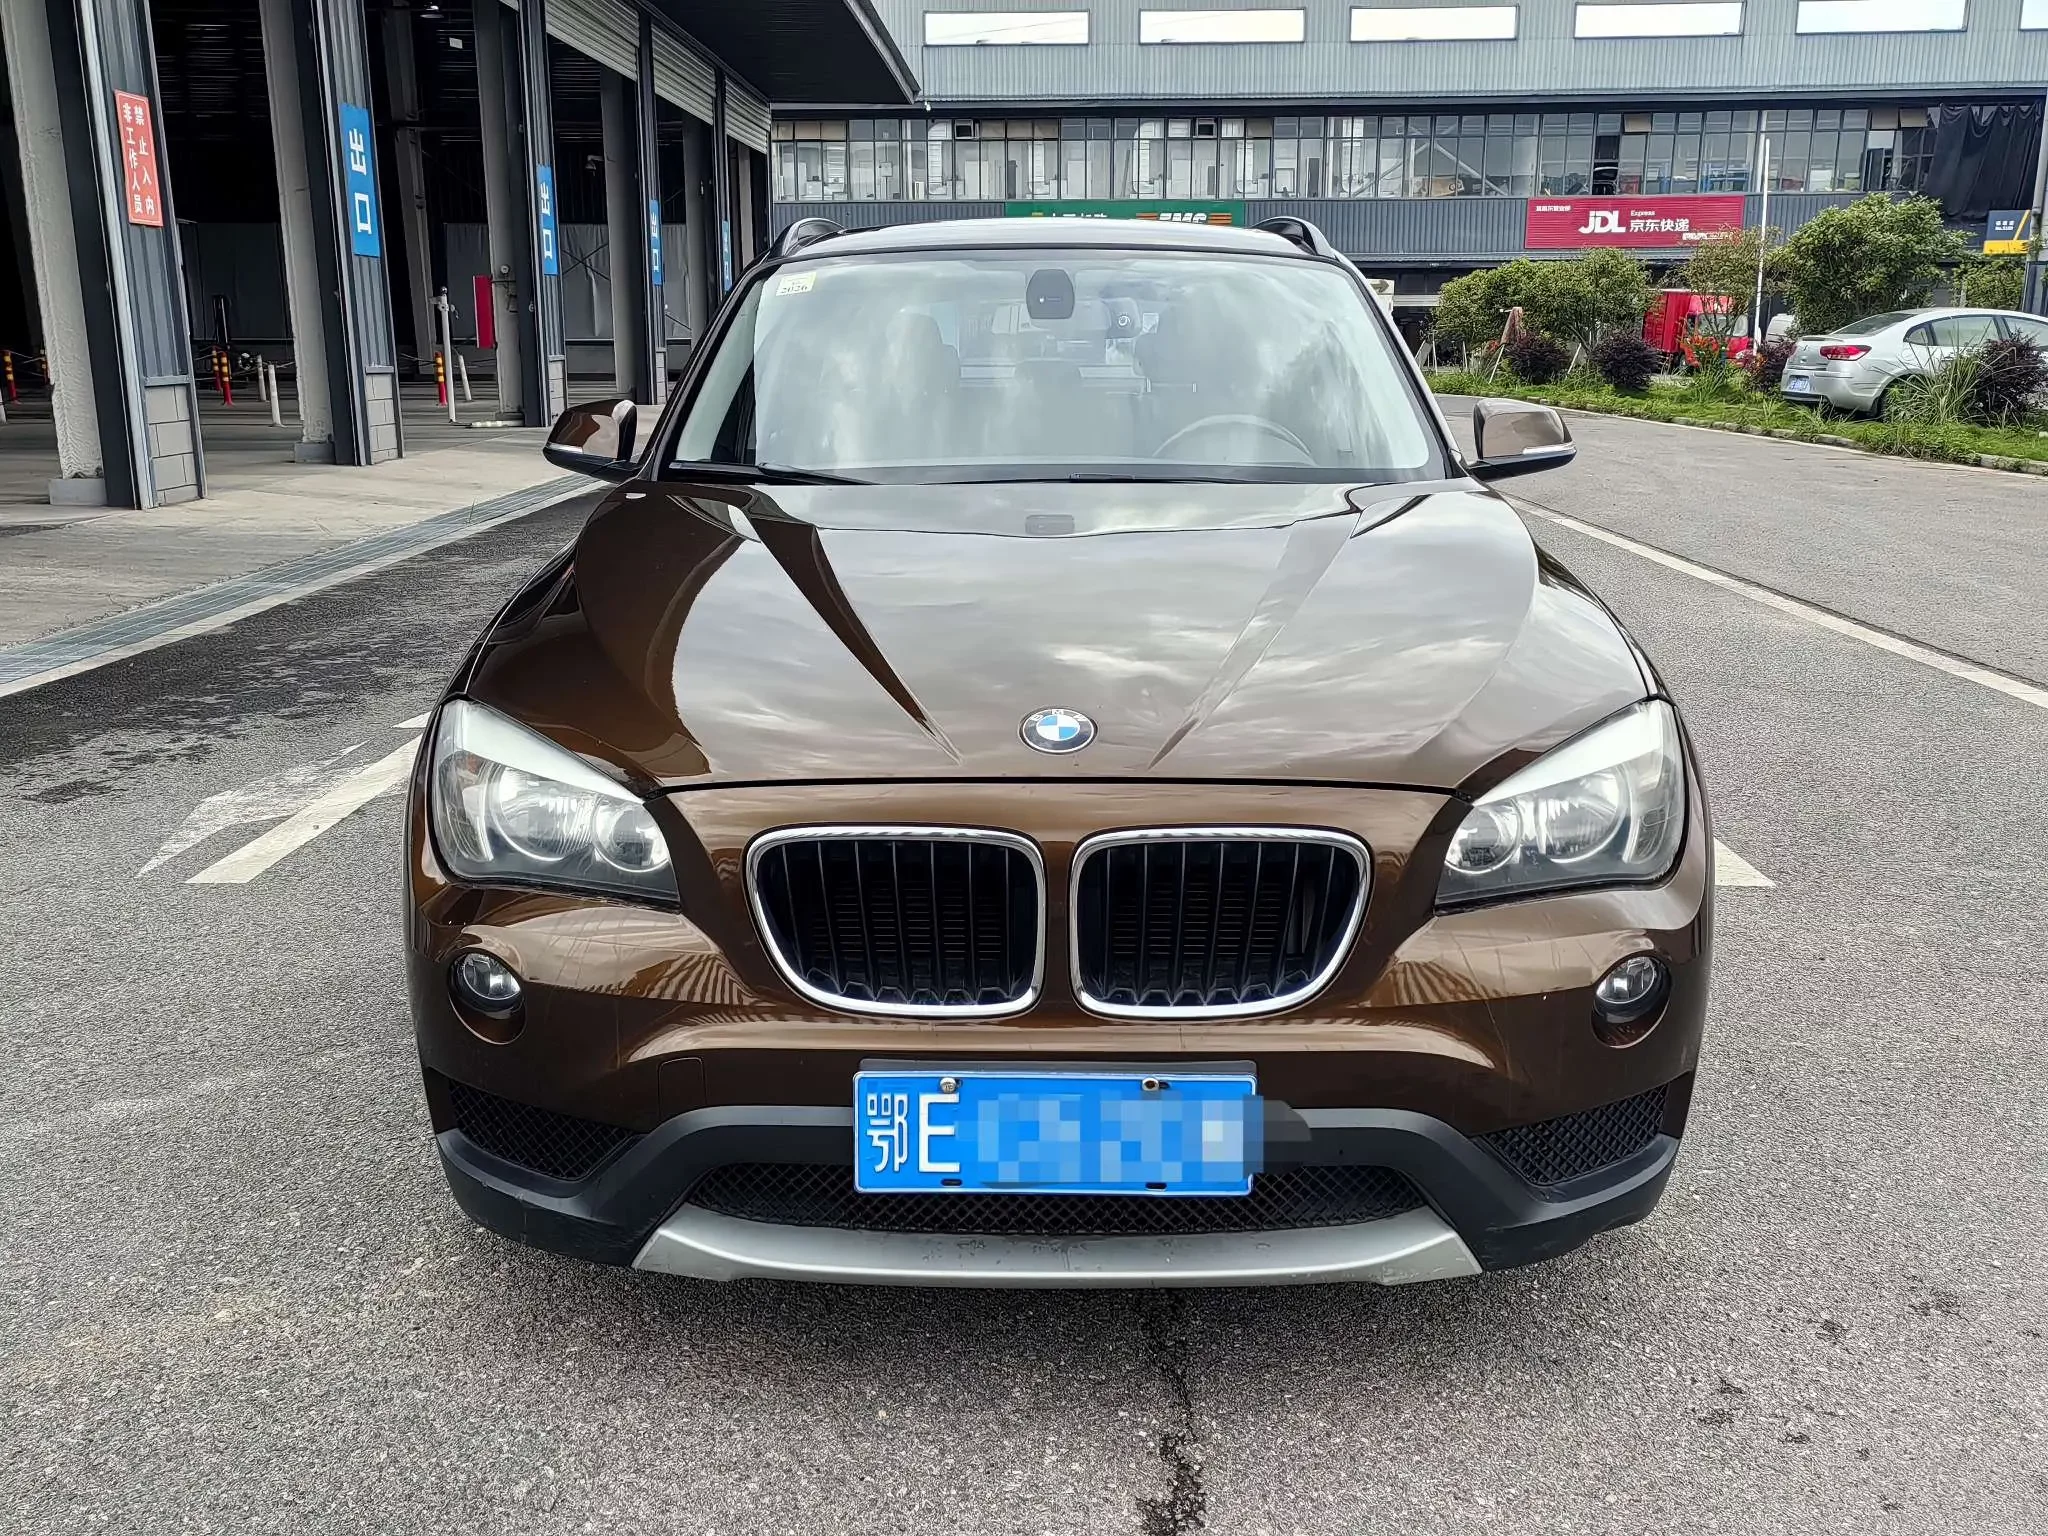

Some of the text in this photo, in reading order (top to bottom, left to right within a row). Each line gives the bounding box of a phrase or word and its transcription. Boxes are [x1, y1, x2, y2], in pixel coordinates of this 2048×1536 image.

[122, 102, 143, 214] 非工作人员
[133, 104, 155, 216] 禁止入内
[349, 128, 372, 235] 出口
[540, 181, 553, 260] 出口
[650, 211, 660, 273] 出口
[1578, 210, 1626, 234] JDL
[1630, 218, 1690, 232] 京东快递
